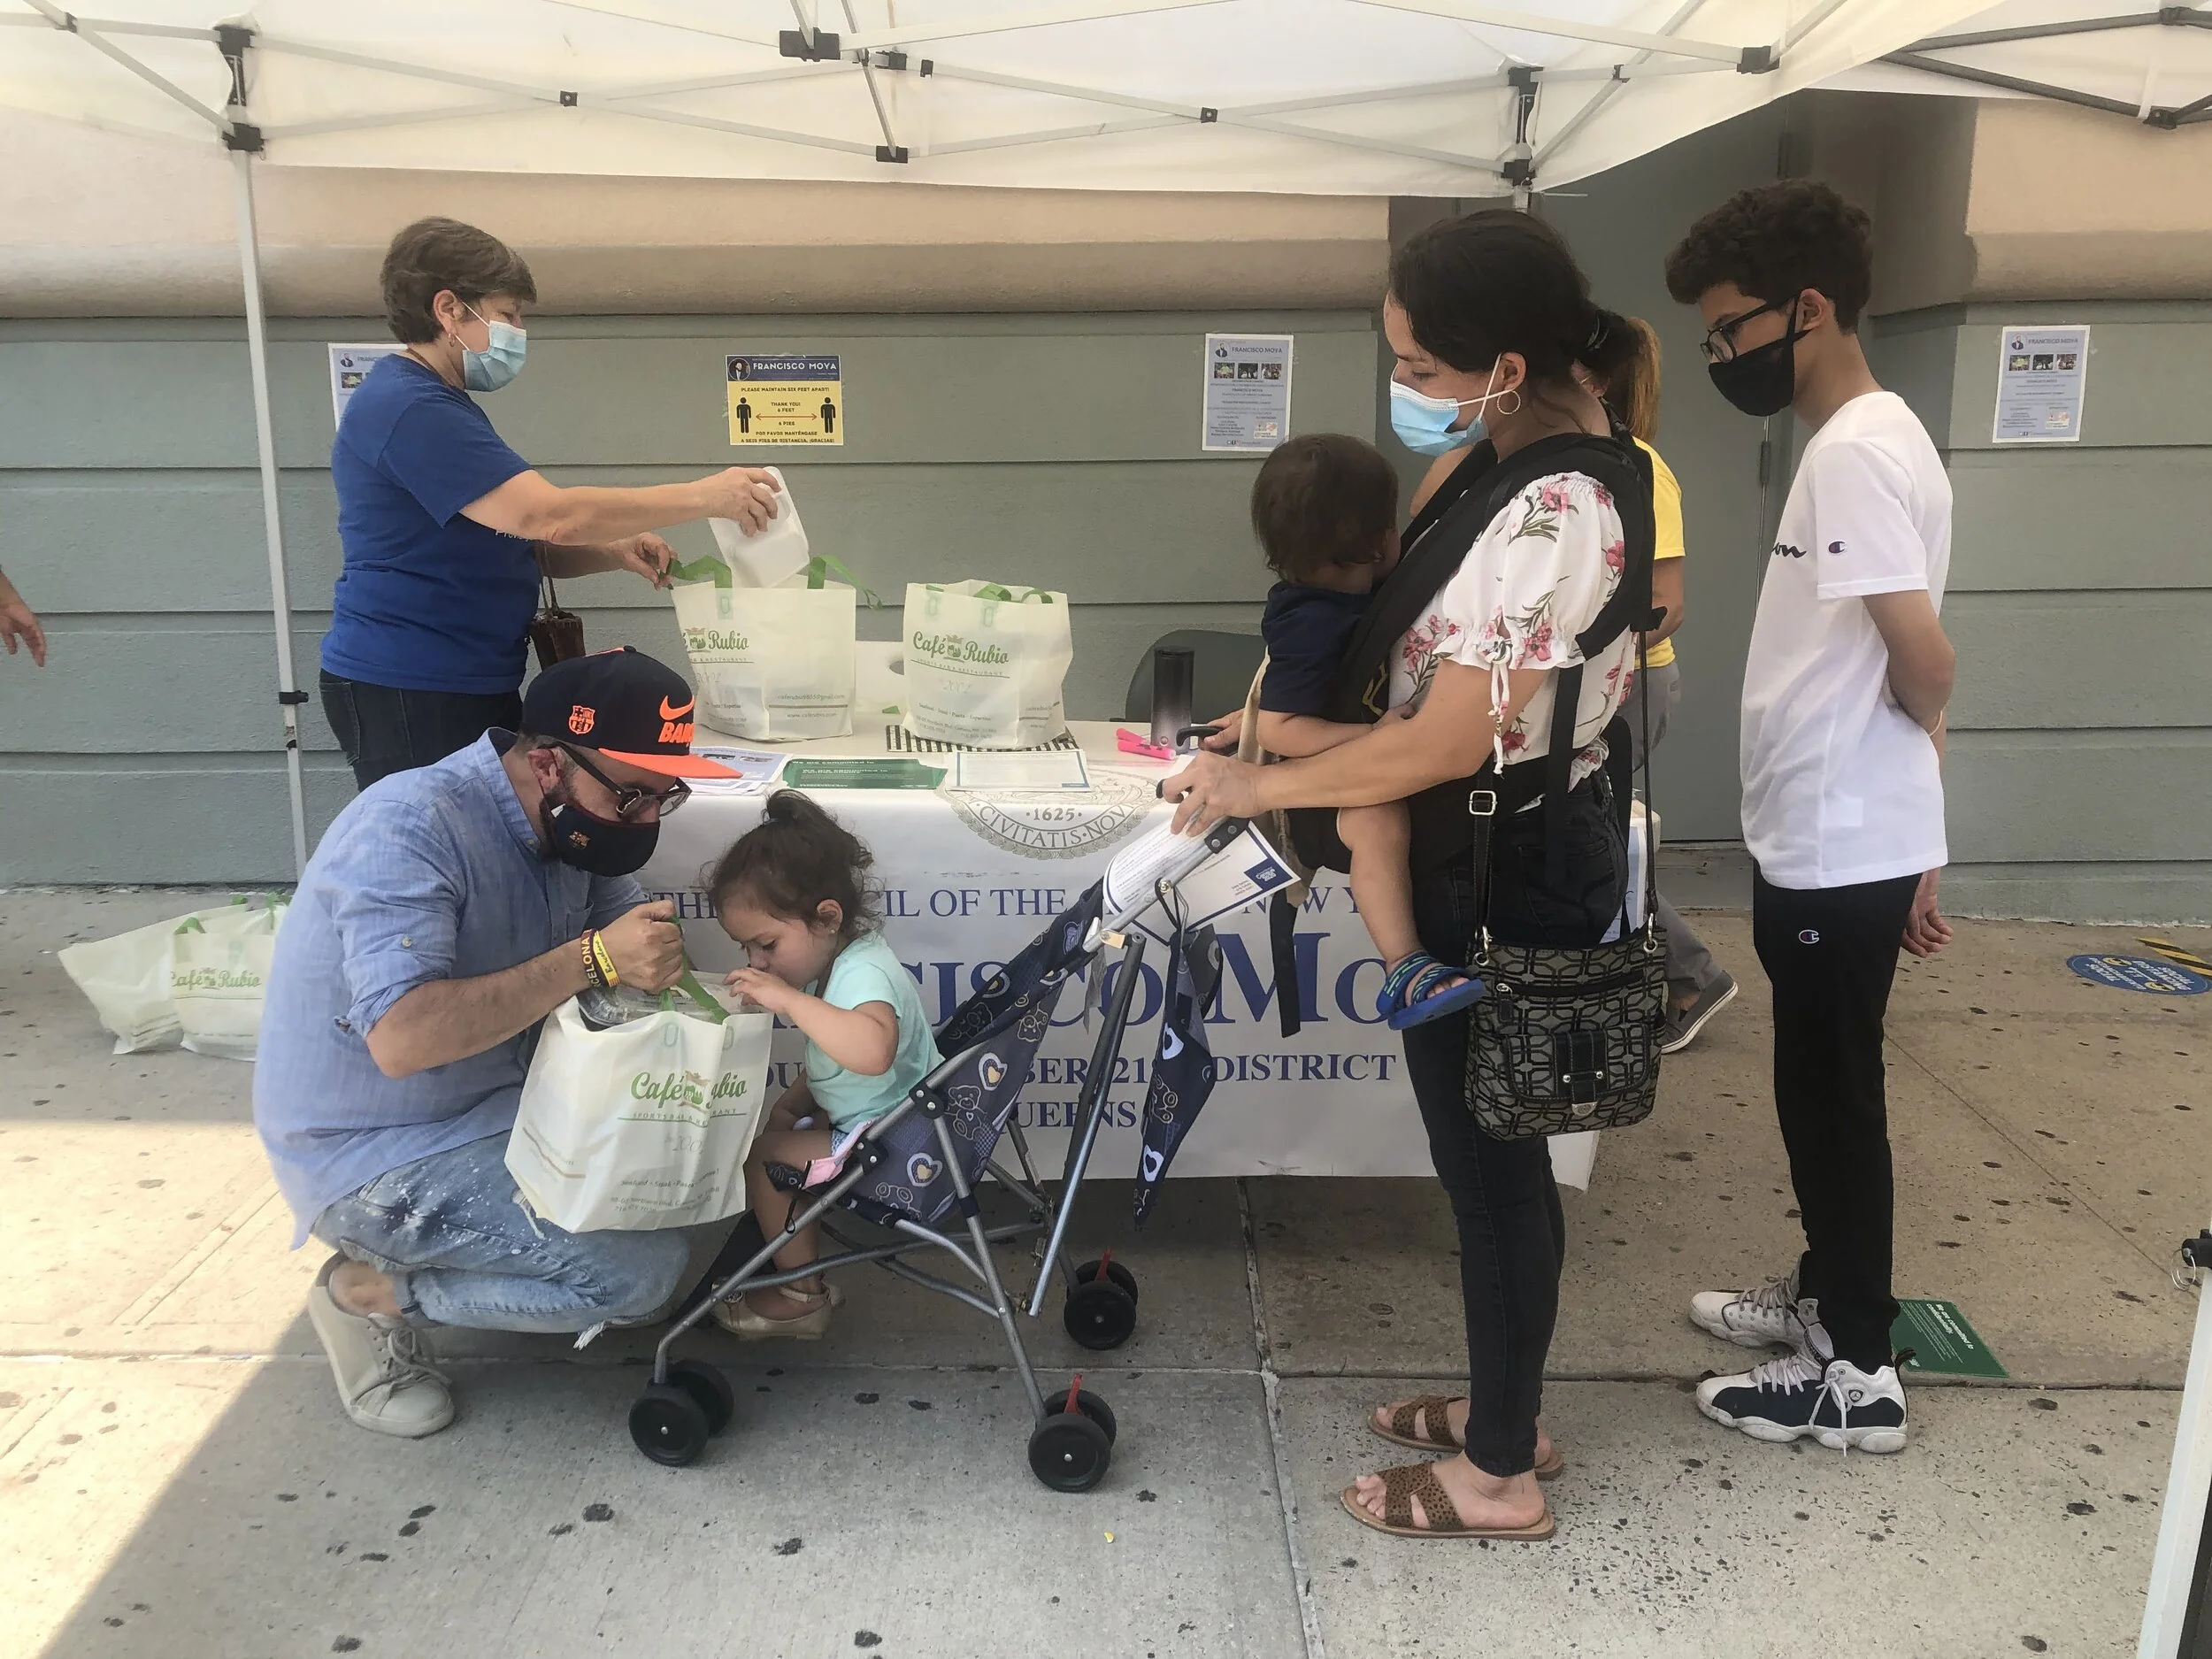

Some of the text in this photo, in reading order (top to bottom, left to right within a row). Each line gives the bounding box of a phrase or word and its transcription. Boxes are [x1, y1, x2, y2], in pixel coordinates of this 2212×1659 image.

[708, 630, 749, 650] Rubio
[913, 631, 1010, 664] Café Rubio
[979, 805, 1083, 848] CIVITATIS
[1033, 807, 1075, 822] 1625
[929, 889, 980, 918] OF
[990, 888, 1066, 917] THE
[218, 970, 262, 988] Rubio
[1215, 1054, 1397, 1082] DISTRICT
[631, 1071, 685, 1109] Café
